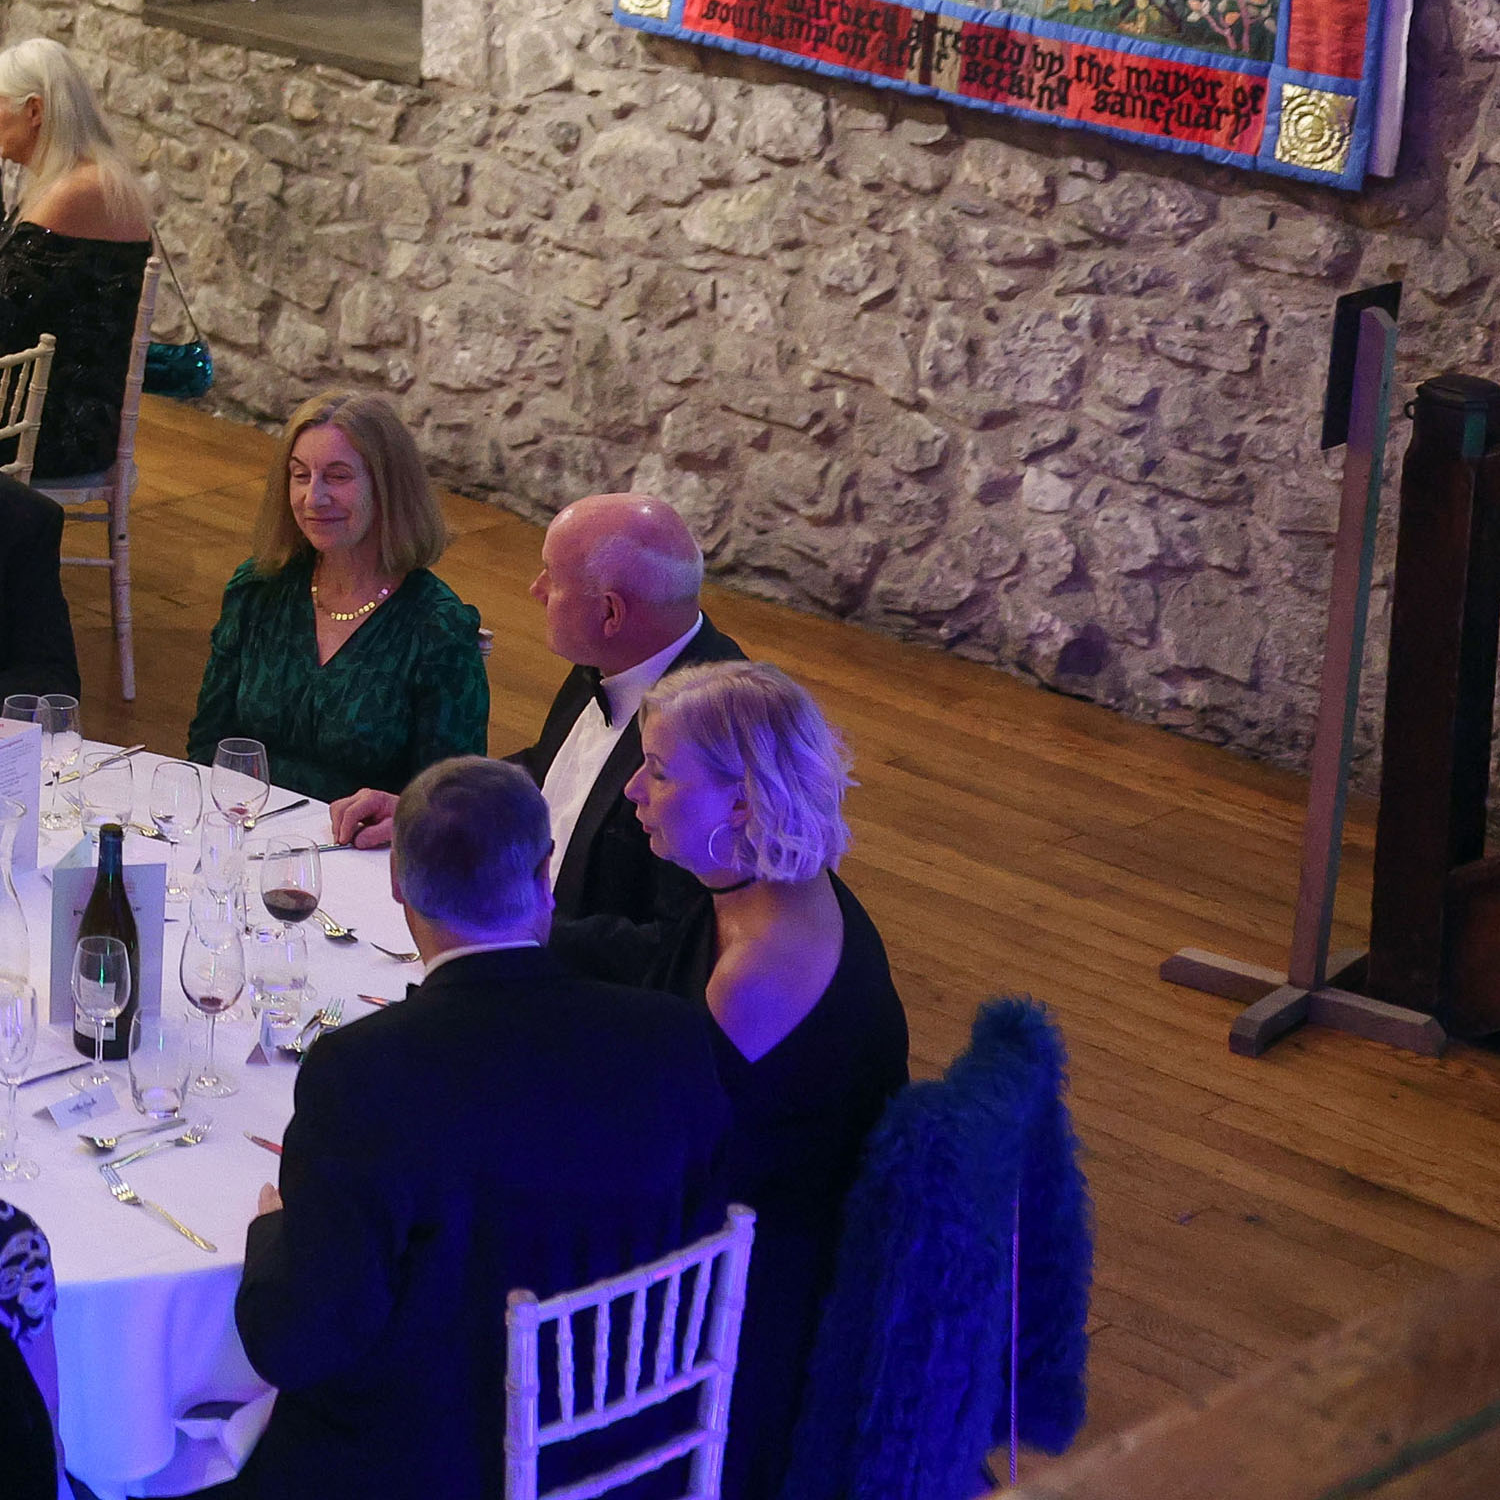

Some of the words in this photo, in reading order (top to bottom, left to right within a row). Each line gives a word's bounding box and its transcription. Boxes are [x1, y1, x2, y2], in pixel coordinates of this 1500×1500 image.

[1033, 44, 1064, 78] by
[1075, 53, 1114, 89] the
[1126, 65, 1222, 101] mayor
[1232, 82, 1264, 114] of
[1093, 88, 1250, 145] sanctuary
